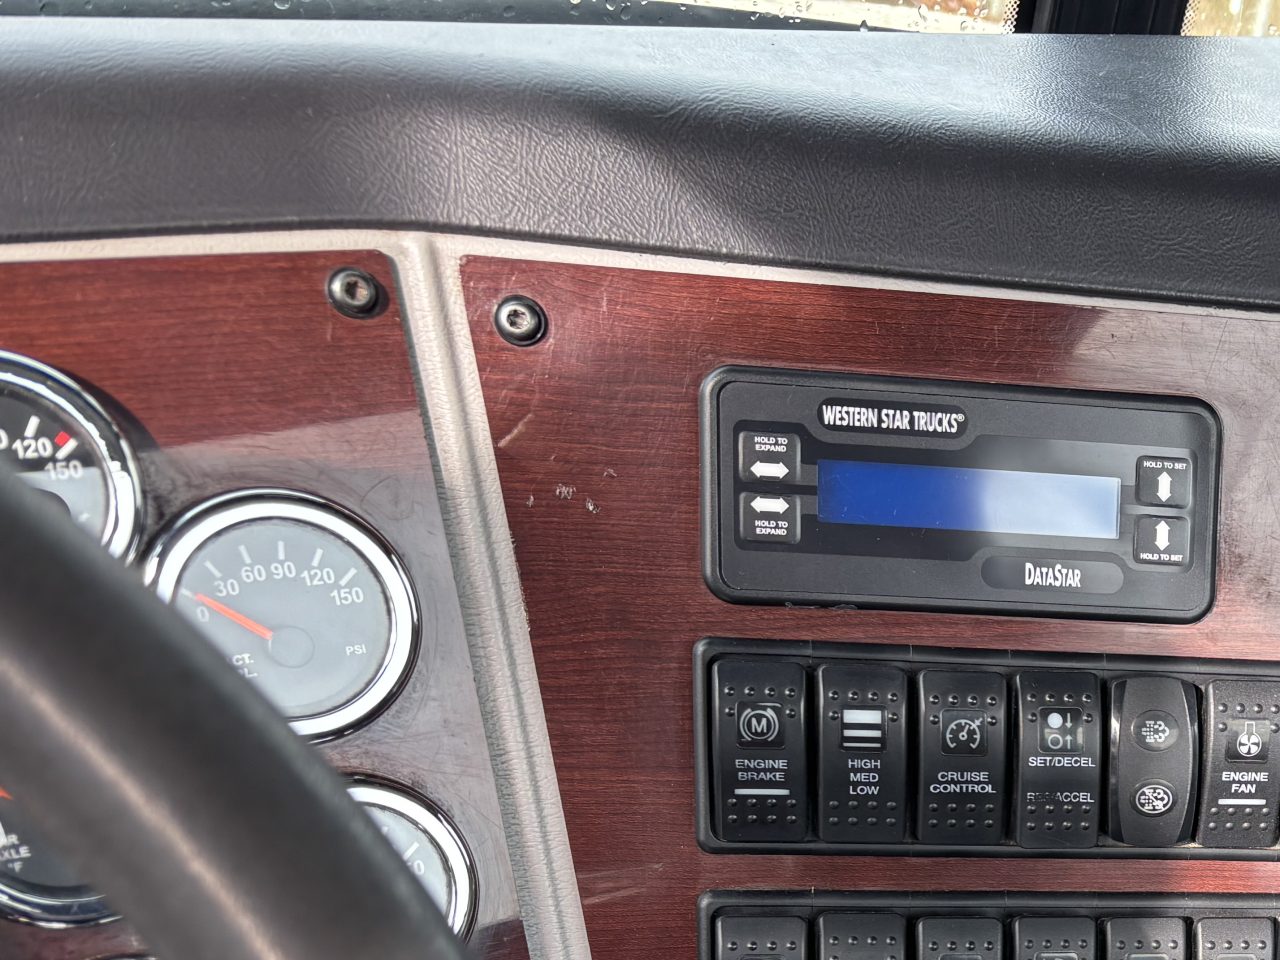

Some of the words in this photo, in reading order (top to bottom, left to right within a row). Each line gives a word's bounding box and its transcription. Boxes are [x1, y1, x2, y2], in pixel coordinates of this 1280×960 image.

[822, 404, 878, 428] WESTERN
[881, 408, 911, 430] STAR
[754, 436, 776, 444] HOLD
[776, 437, 788, 445] TO
[12, 436, 53, 460] 120
[755, 444, 787, 452] EXPAND
[44, 459, 83, 480] 150
[754, 520, 776, 528] HOLD
[777, 520, 788, 528] TO
[756, 527, 787, 536] EXPAND
[1170, 554, 1184, 562] SET
[240, 564, 266, 583] 60
[270, 561, 296, 579] 90
[300, 568, 335, 586] 120
[213, 579, 240, 597] 30
[330, 587, 364, 606] 150
[196, 606, 210, 622] 0
[345, 644, 367, 656] PSI
[735, 759, 788, 770] ENGINE
[848, 758, 881, 770] HIGH
[1028, 756, 1096, 767] SET/DECEL
[737, 771, 786, 782] BRAKE
[849, 772, 879, 783] MED
[937, 771, 990, 782] CRUISE
[1221, 771, 1269, 783] ENGINE
[849, 785, 880, 796] LOW
[929, 783, 997, 794] CONTROL
[1231, 783, 1256, 794] FAN
